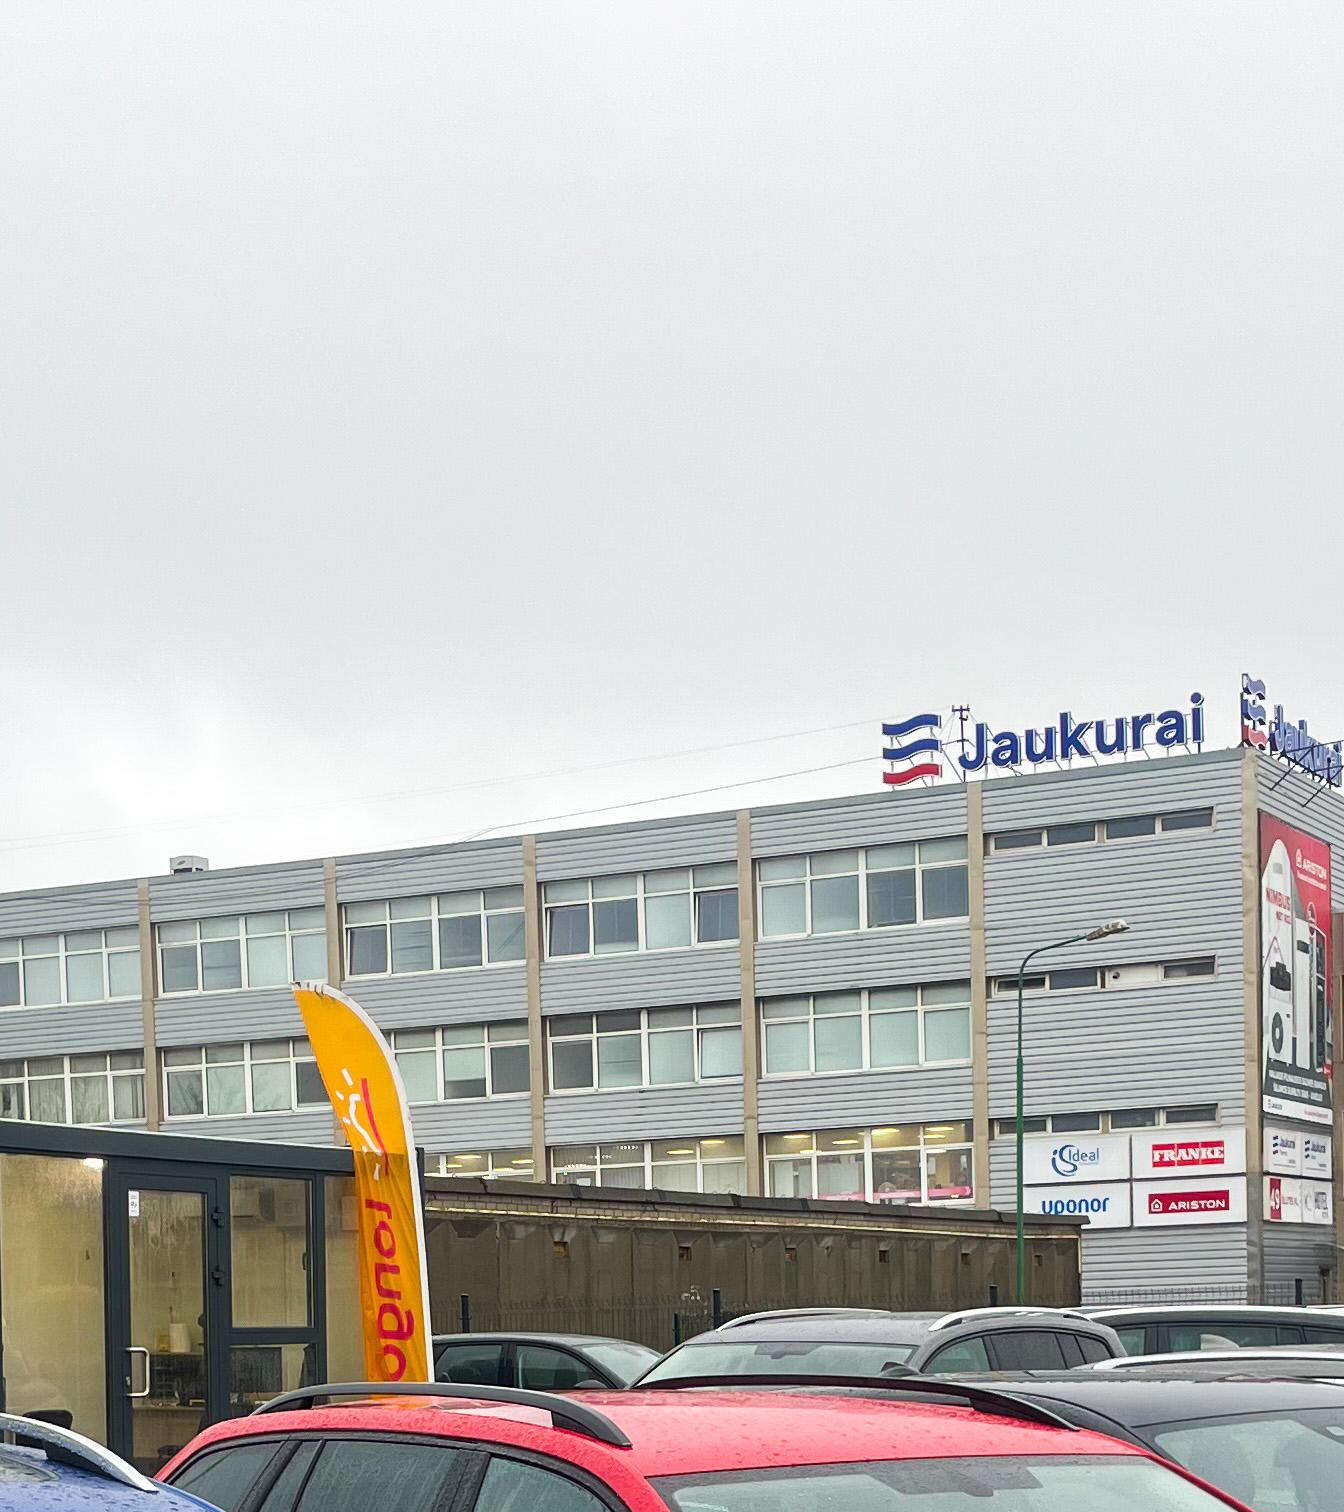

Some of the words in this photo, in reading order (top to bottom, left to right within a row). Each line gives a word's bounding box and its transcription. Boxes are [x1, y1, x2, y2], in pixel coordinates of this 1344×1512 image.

[958, 692, 1205, 771] Jaukurai
[1152, 1146, 1224, 1162] FRANKE
[1041, 1197, 1110, 1215] uponor
[1168, 1199, 1226, 1211] ARISTON
